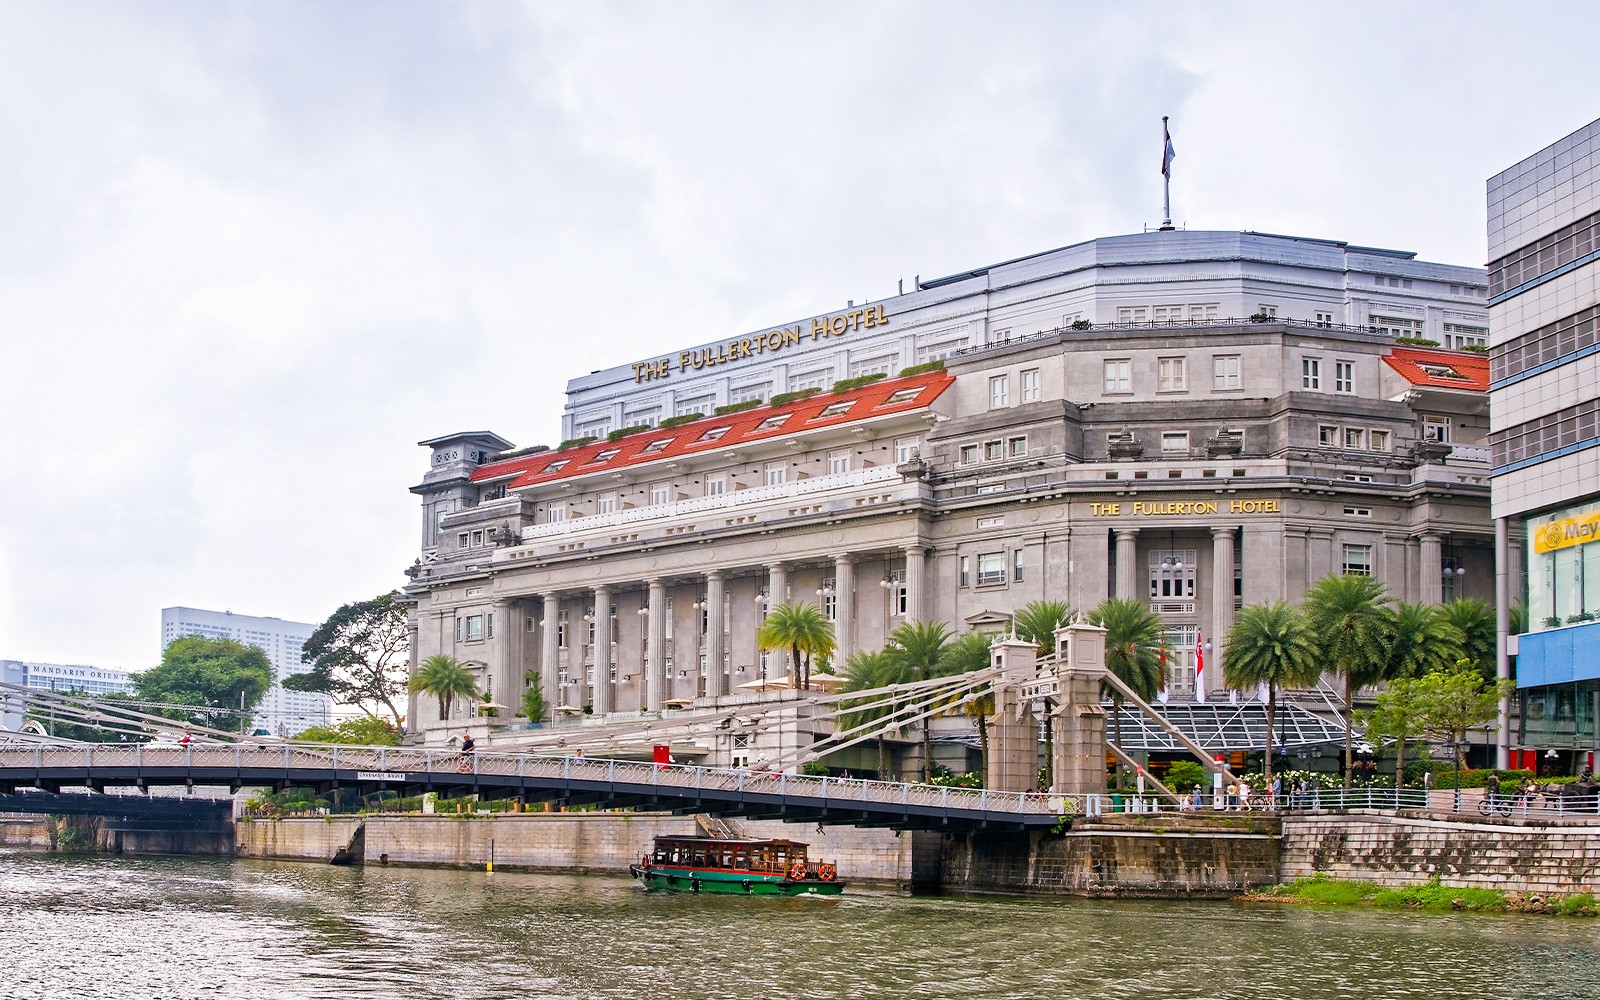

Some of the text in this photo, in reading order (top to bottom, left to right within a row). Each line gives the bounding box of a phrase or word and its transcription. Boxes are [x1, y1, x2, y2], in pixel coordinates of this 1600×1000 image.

[631, 304, 888, 383] THE FULLERTON HOTEL
[1090, 500, 1281, 516] THE FULLERTON HOTEL
[33, 665, 85, 677] MANDARIN
